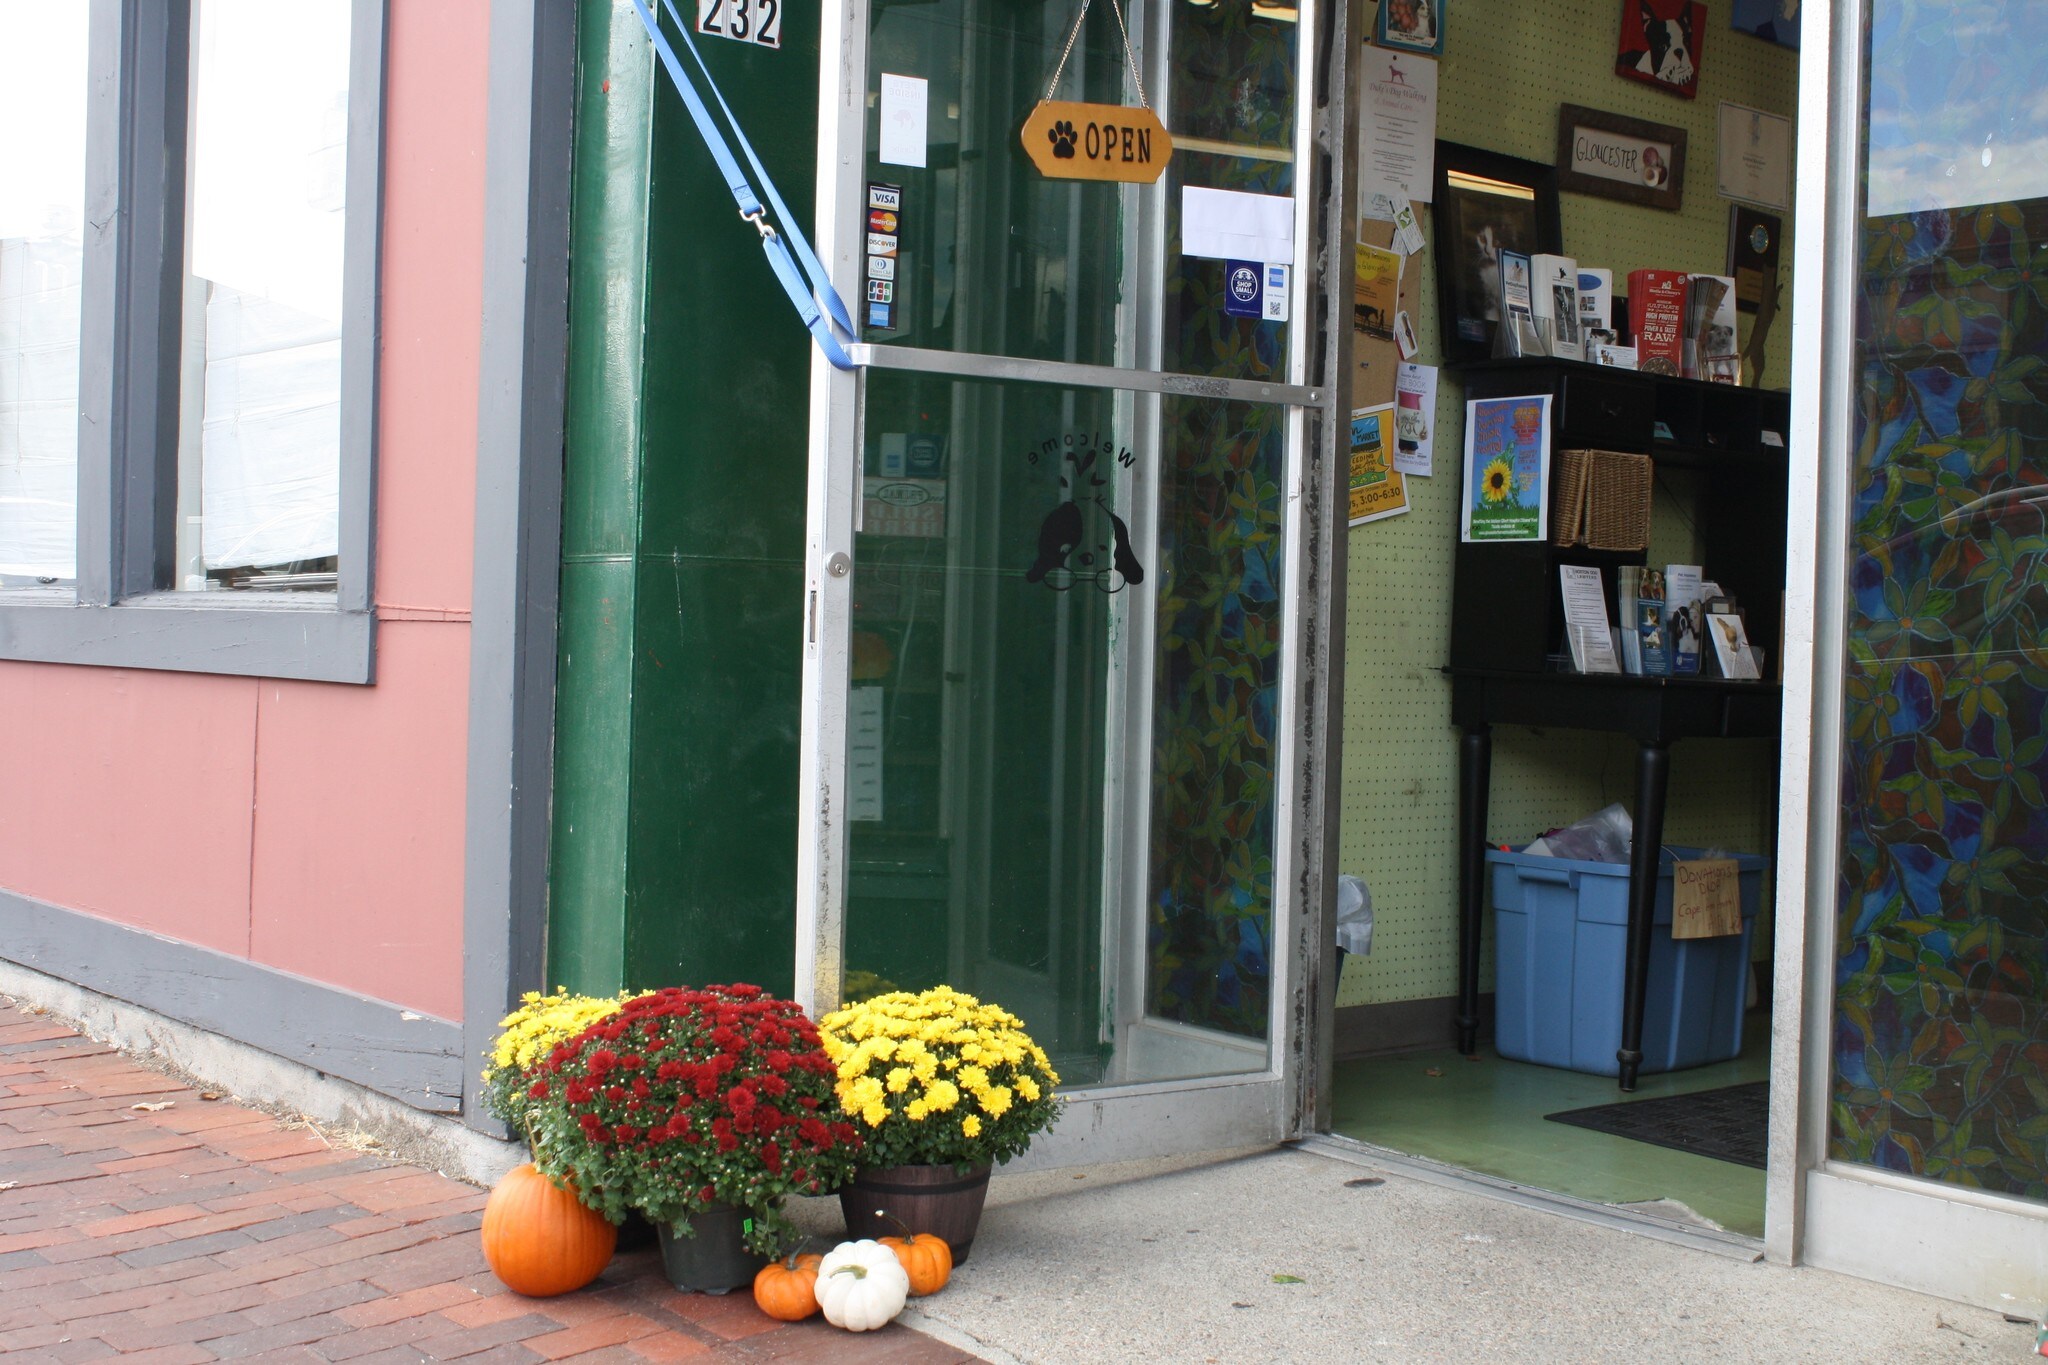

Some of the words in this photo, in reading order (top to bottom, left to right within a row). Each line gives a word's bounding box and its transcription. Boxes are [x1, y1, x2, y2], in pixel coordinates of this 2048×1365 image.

[703, 0, 778, 44] 232
[1085, 121, 1151, 164] OPEN
[1576, 136, 1638, 174] GLOUCESTER
[874, 192, 896, 205] VISA
[870, 217, 896, 226] MasterCard
[868, 238, 896, 248] DISCOVER
[1236, 280, 1252, 288] SHOP
[868, 286, 891, 296] JCB
[1235, 286, 1253, 295] SMALL
[1646, 312, 1658, 320] HIGH
[1658, 313, 1679, 321] PROTEIN
[1643, 331, 1677, 342] RAW
[1356, 431, 1379, 443] MARKET
[1352, 453, 1374, 464] EEDING
[1360, 487, 1401, 506] 3:00-6:30
[1678, 903, 1702, 920] Cape
